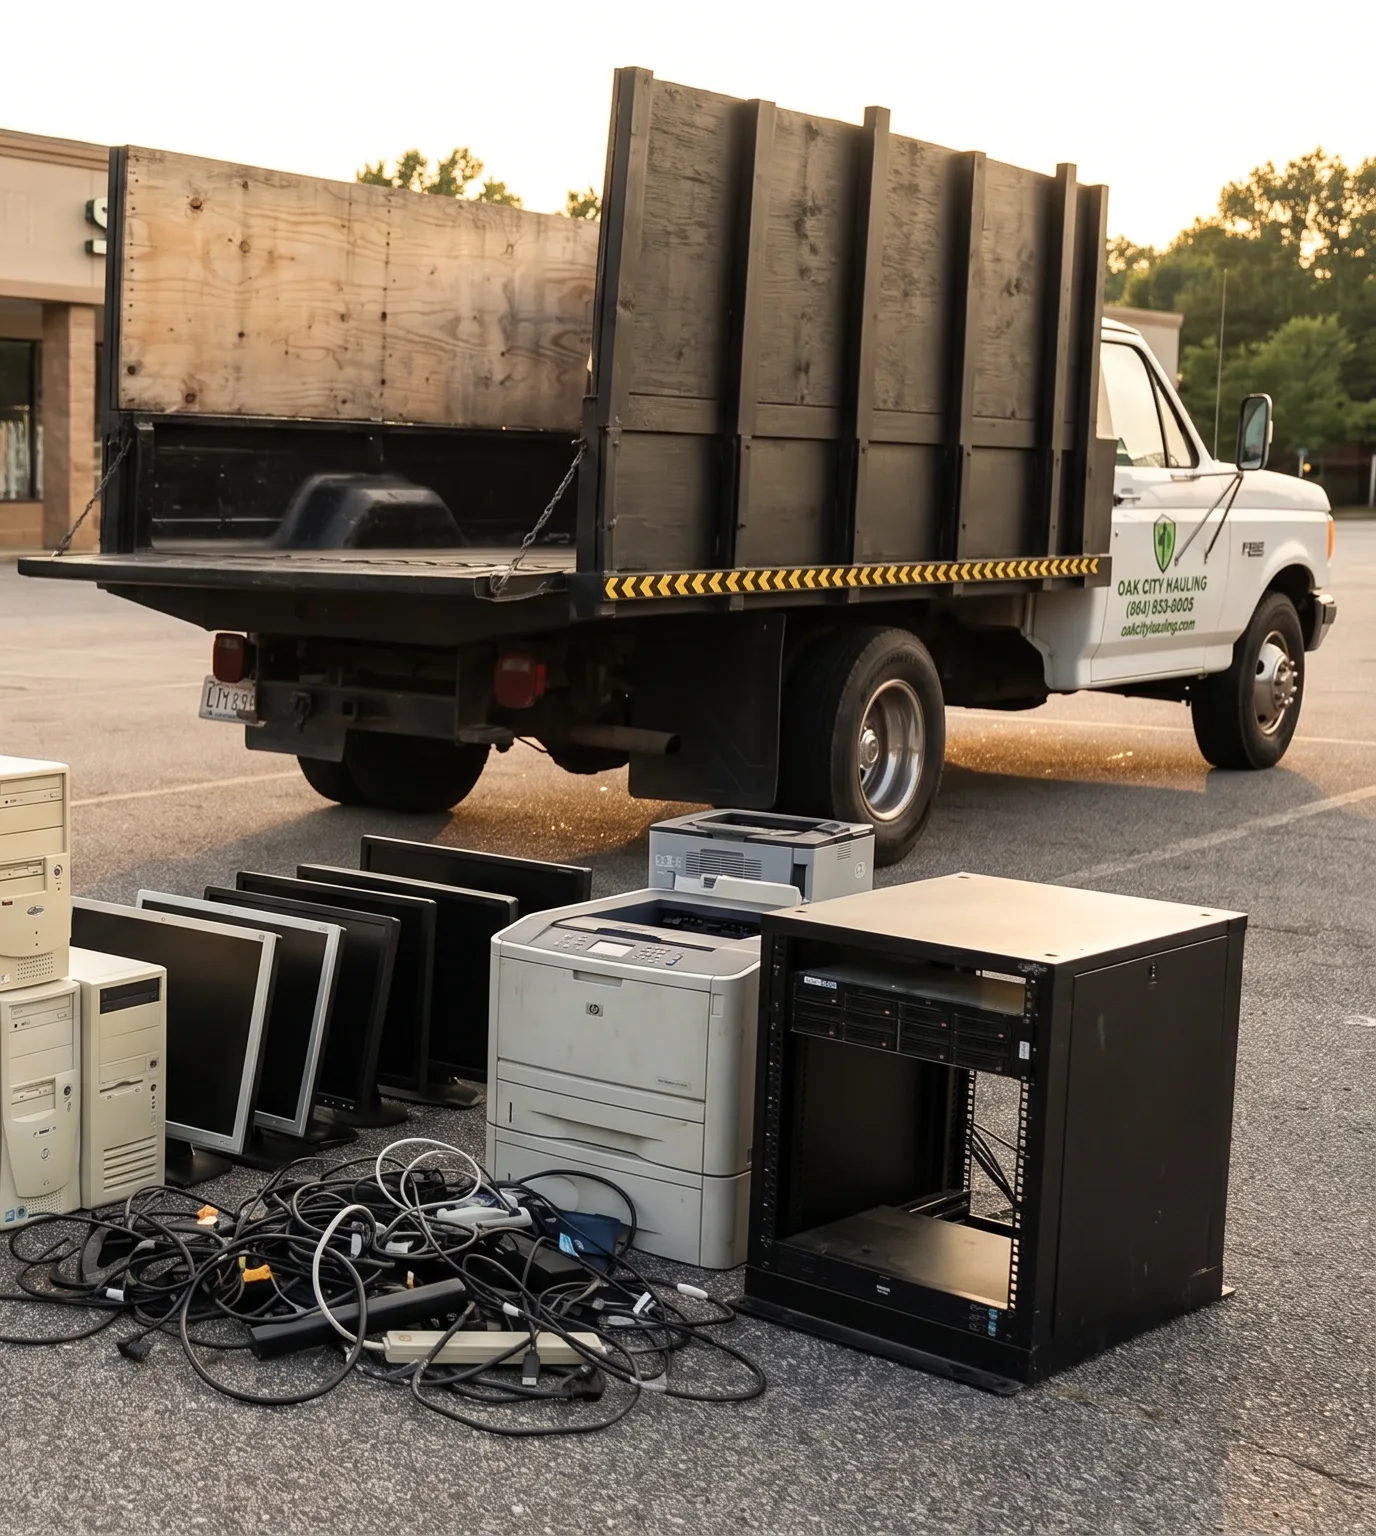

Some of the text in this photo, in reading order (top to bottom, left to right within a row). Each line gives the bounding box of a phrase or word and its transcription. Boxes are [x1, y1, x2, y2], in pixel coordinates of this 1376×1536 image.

[1118, 575, 1207, 596] OAK CITY HAULING
